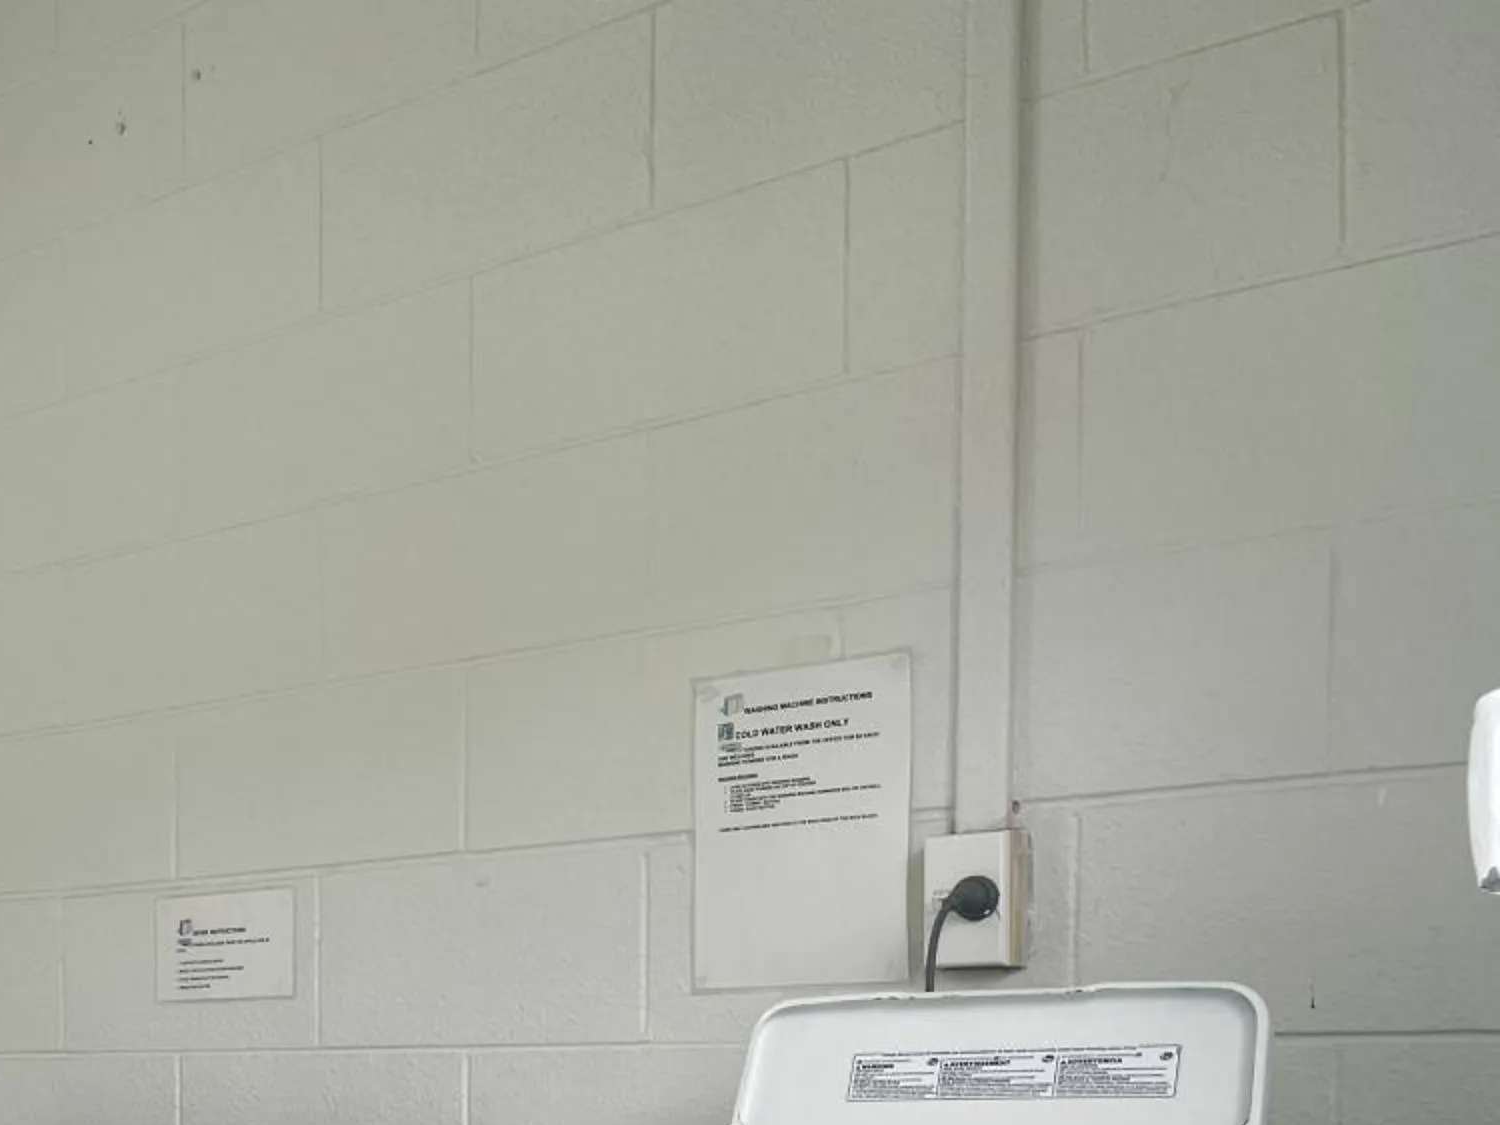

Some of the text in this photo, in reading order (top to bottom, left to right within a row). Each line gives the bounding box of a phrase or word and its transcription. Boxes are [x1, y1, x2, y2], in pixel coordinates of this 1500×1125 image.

[815, 691, 873, 705] INSTRUCTIONS
[735, 717, 850, 740] COLD WATER WASH ONLY
